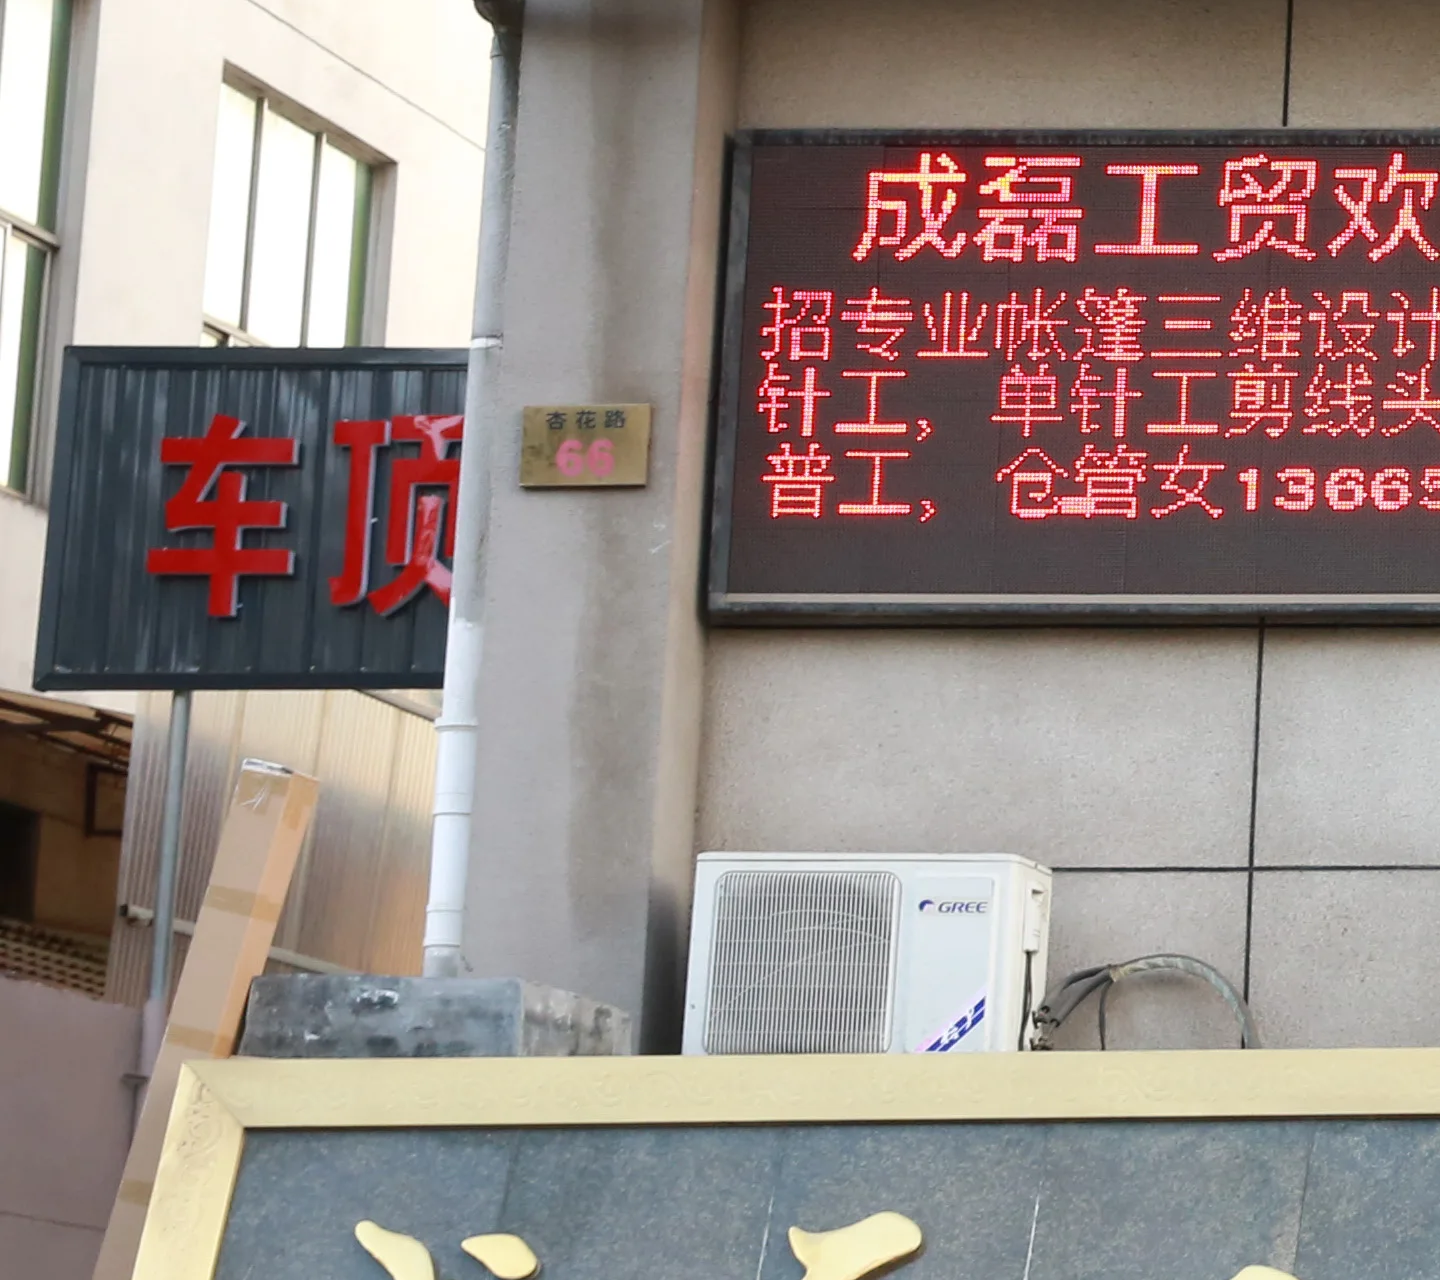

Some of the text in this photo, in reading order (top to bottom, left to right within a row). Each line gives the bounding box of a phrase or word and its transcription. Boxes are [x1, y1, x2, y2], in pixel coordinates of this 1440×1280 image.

[545, 409, 626, 432] 杏花路
[555, 437, 615, 478] 66
[147, 414, 464, 618] 车顶
[938, 901, 989, 914] GREE
